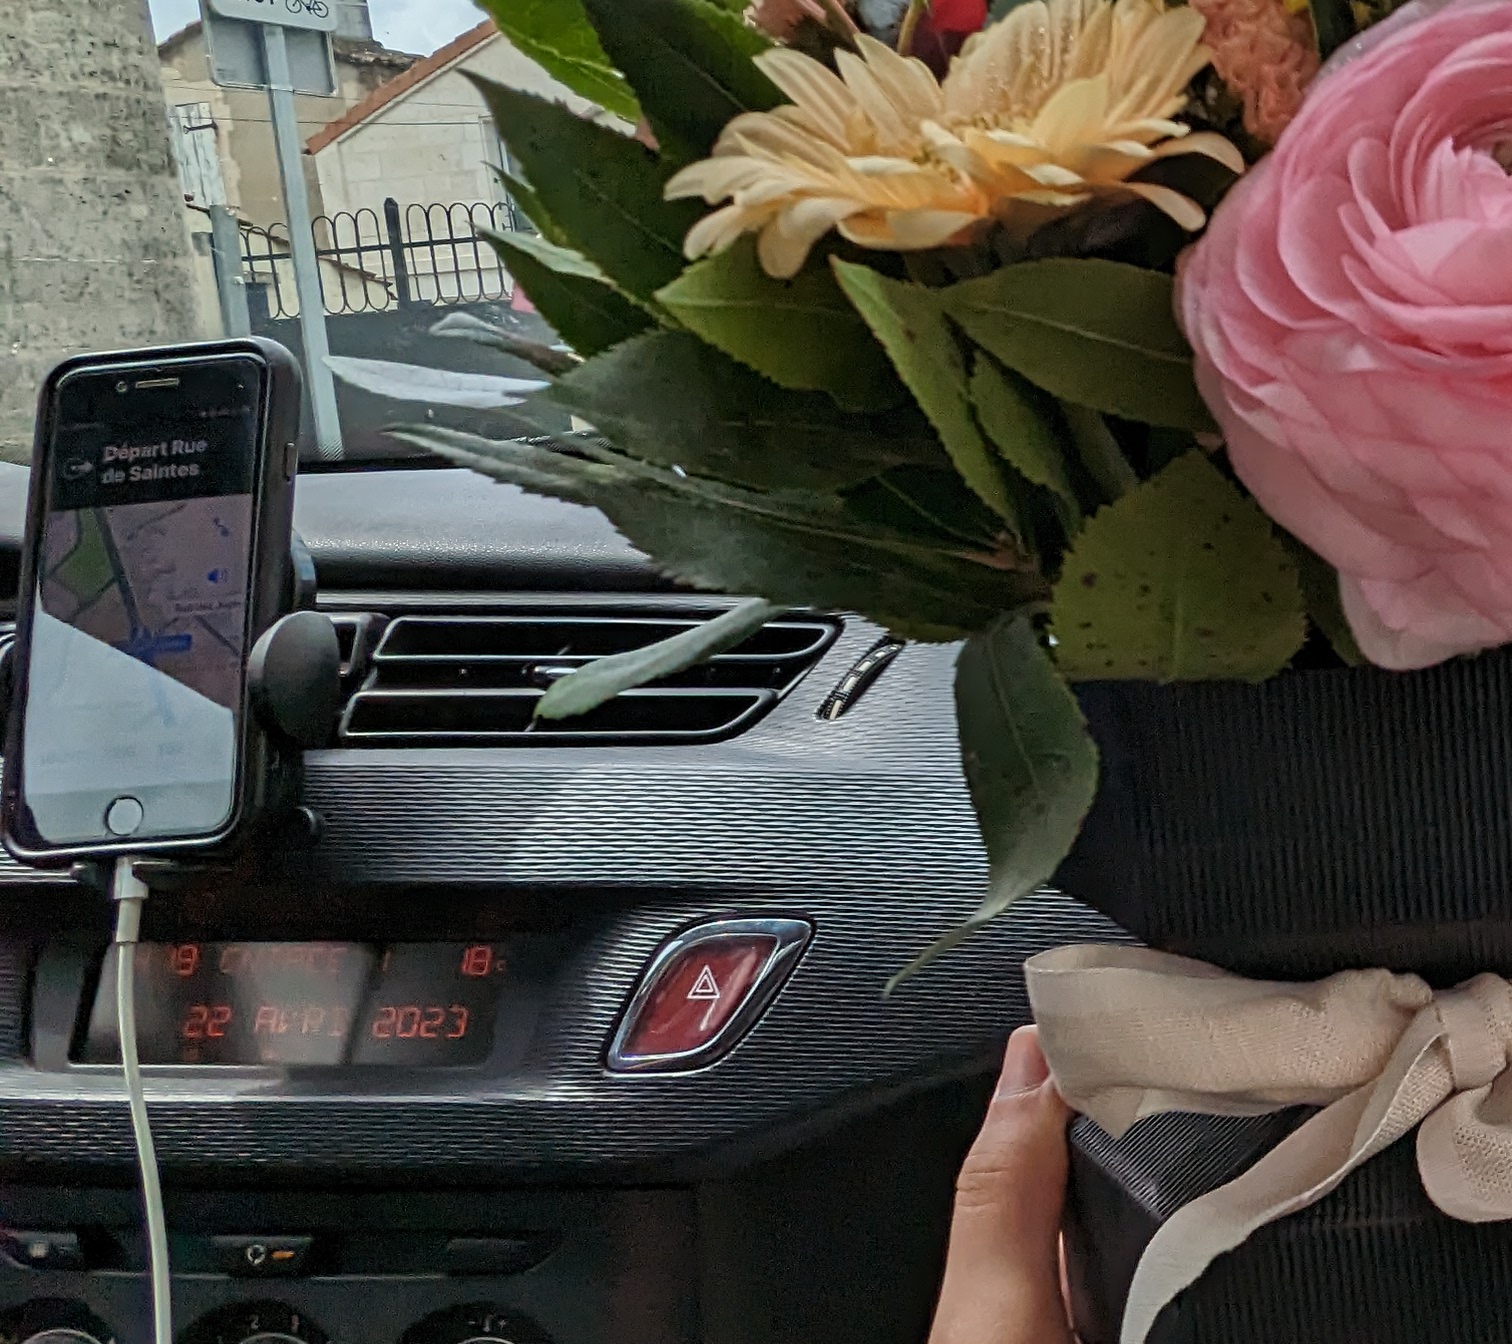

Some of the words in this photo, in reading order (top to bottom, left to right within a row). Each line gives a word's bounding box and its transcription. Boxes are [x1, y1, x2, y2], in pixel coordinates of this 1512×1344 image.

[103, 441, 168, 462] Départ
[171, 439, 209, 454] Rue
[102, 467, 126, 484] de
[129, 463, 200, 482] Saintes
[182, 1005, 233, 1037] 22
[371, 1005, 469, 1038] 2023
